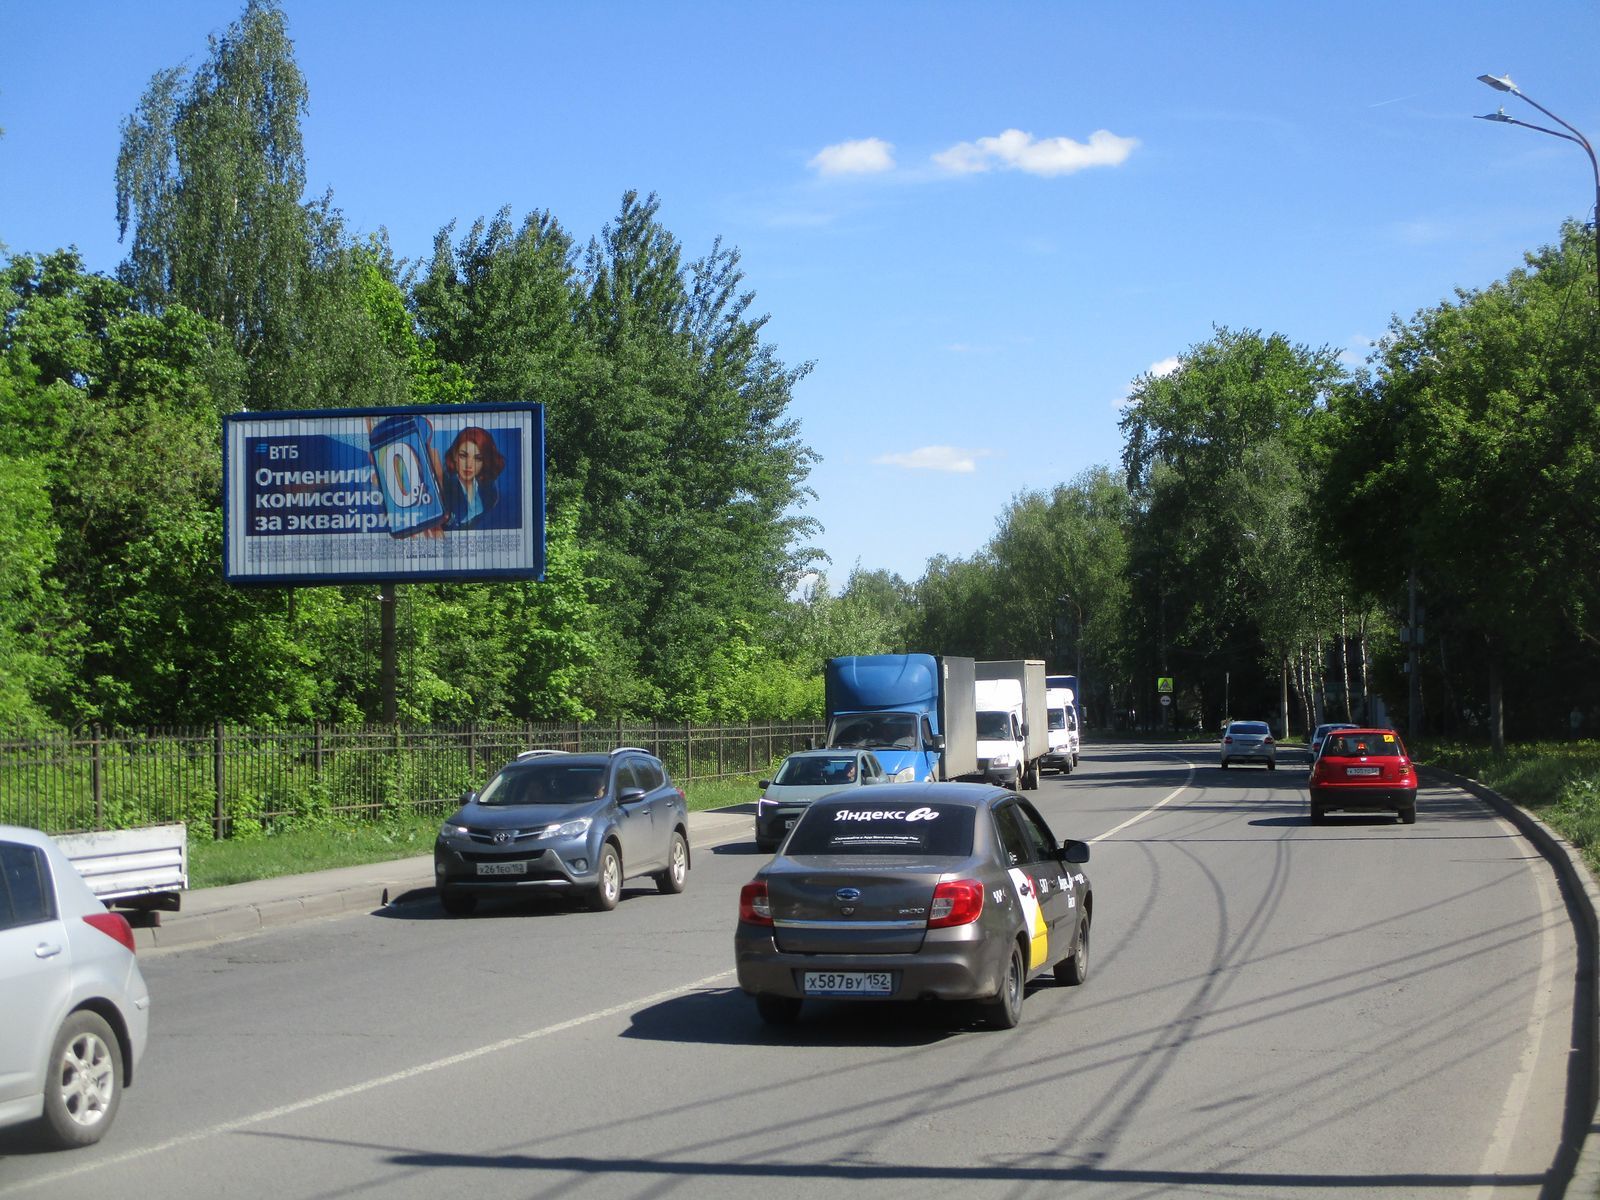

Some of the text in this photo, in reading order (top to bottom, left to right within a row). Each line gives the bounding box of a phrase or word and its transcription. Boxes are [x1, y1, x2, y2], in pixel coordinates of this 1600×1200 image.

[269, 445, 299, 460] ВТБ
[255, 467, 374, 487] Отменили
[255, 490, 384, 509] комиссию
[255, 508, 423, 533] за эквайринг
[834, 807, 939, 822] Яндекс Go
[809, 974, 888, 989] Х587ВУ 152
